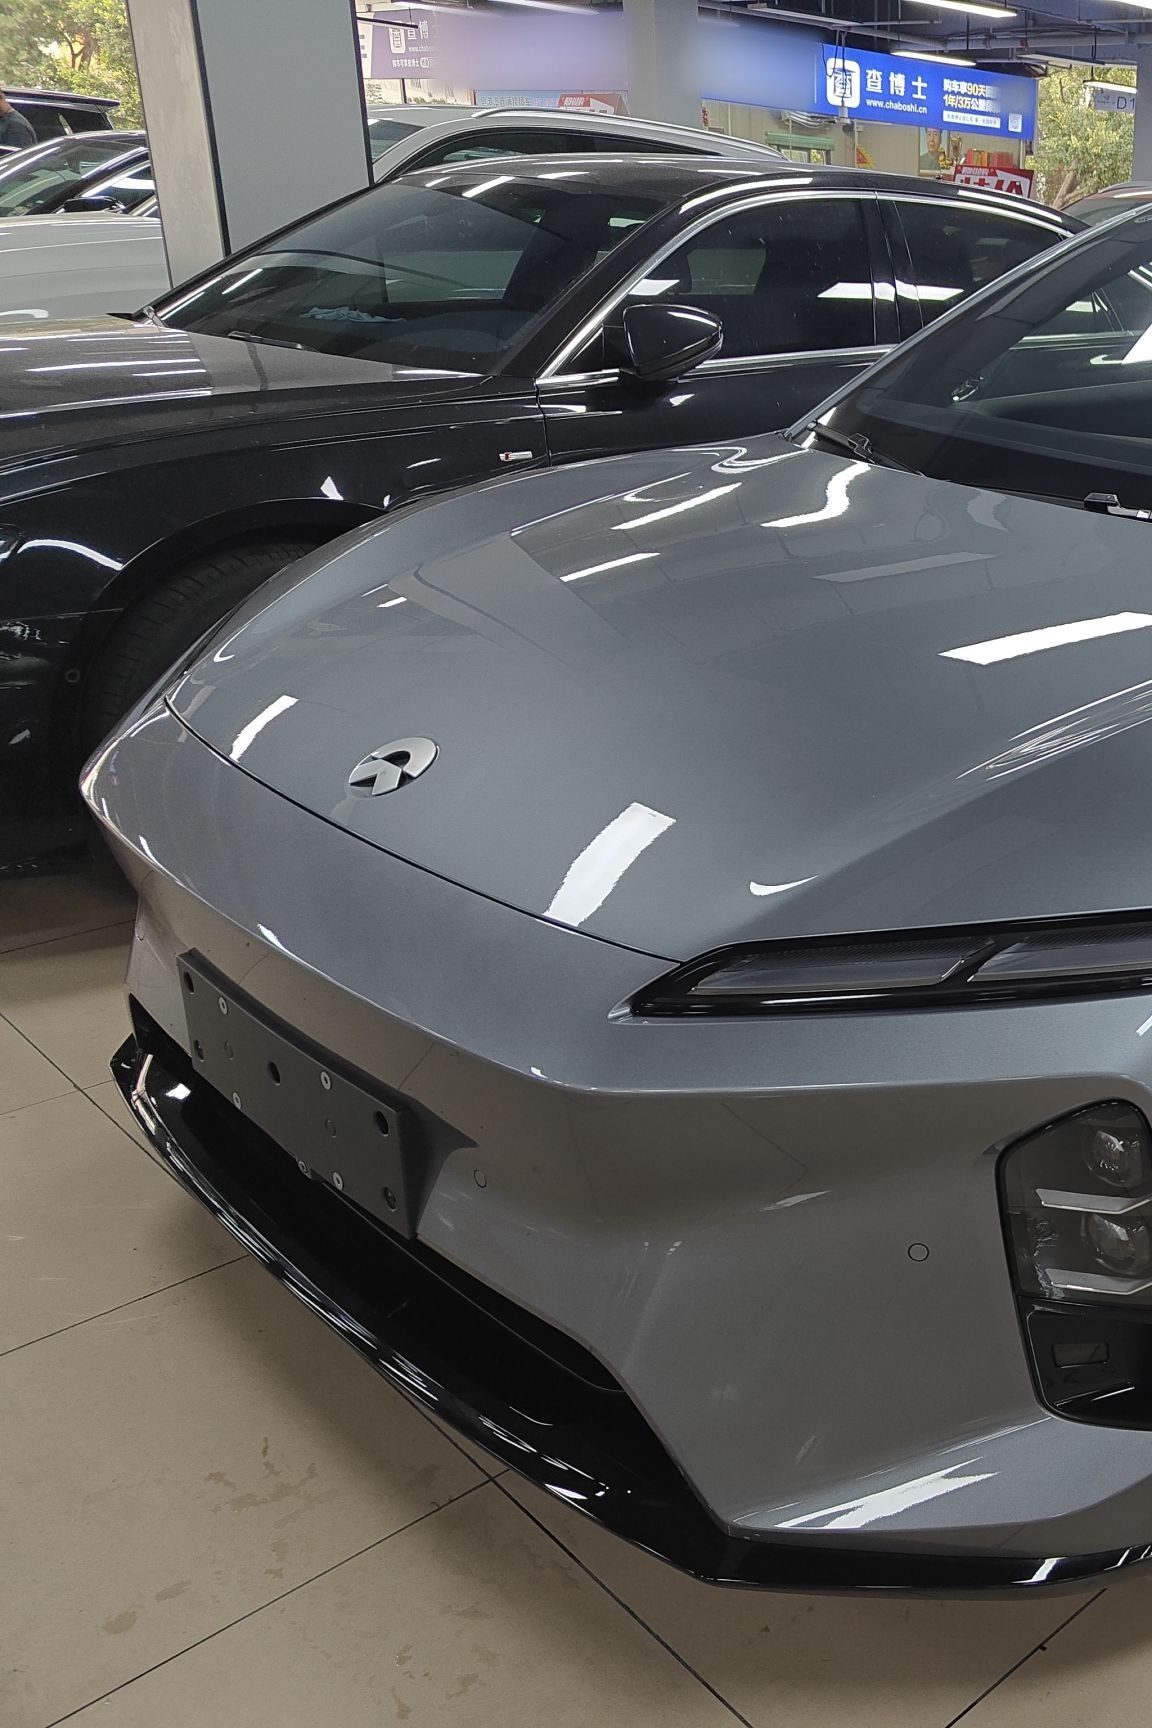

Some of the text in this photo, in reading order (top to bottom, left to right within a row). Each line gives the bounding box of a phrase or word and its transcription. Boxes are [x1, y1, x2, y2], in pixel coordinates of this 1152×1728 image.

[865, 68, 928, 101] 查博士
[865, 98, 928, 115] www.chaboshi.cn
